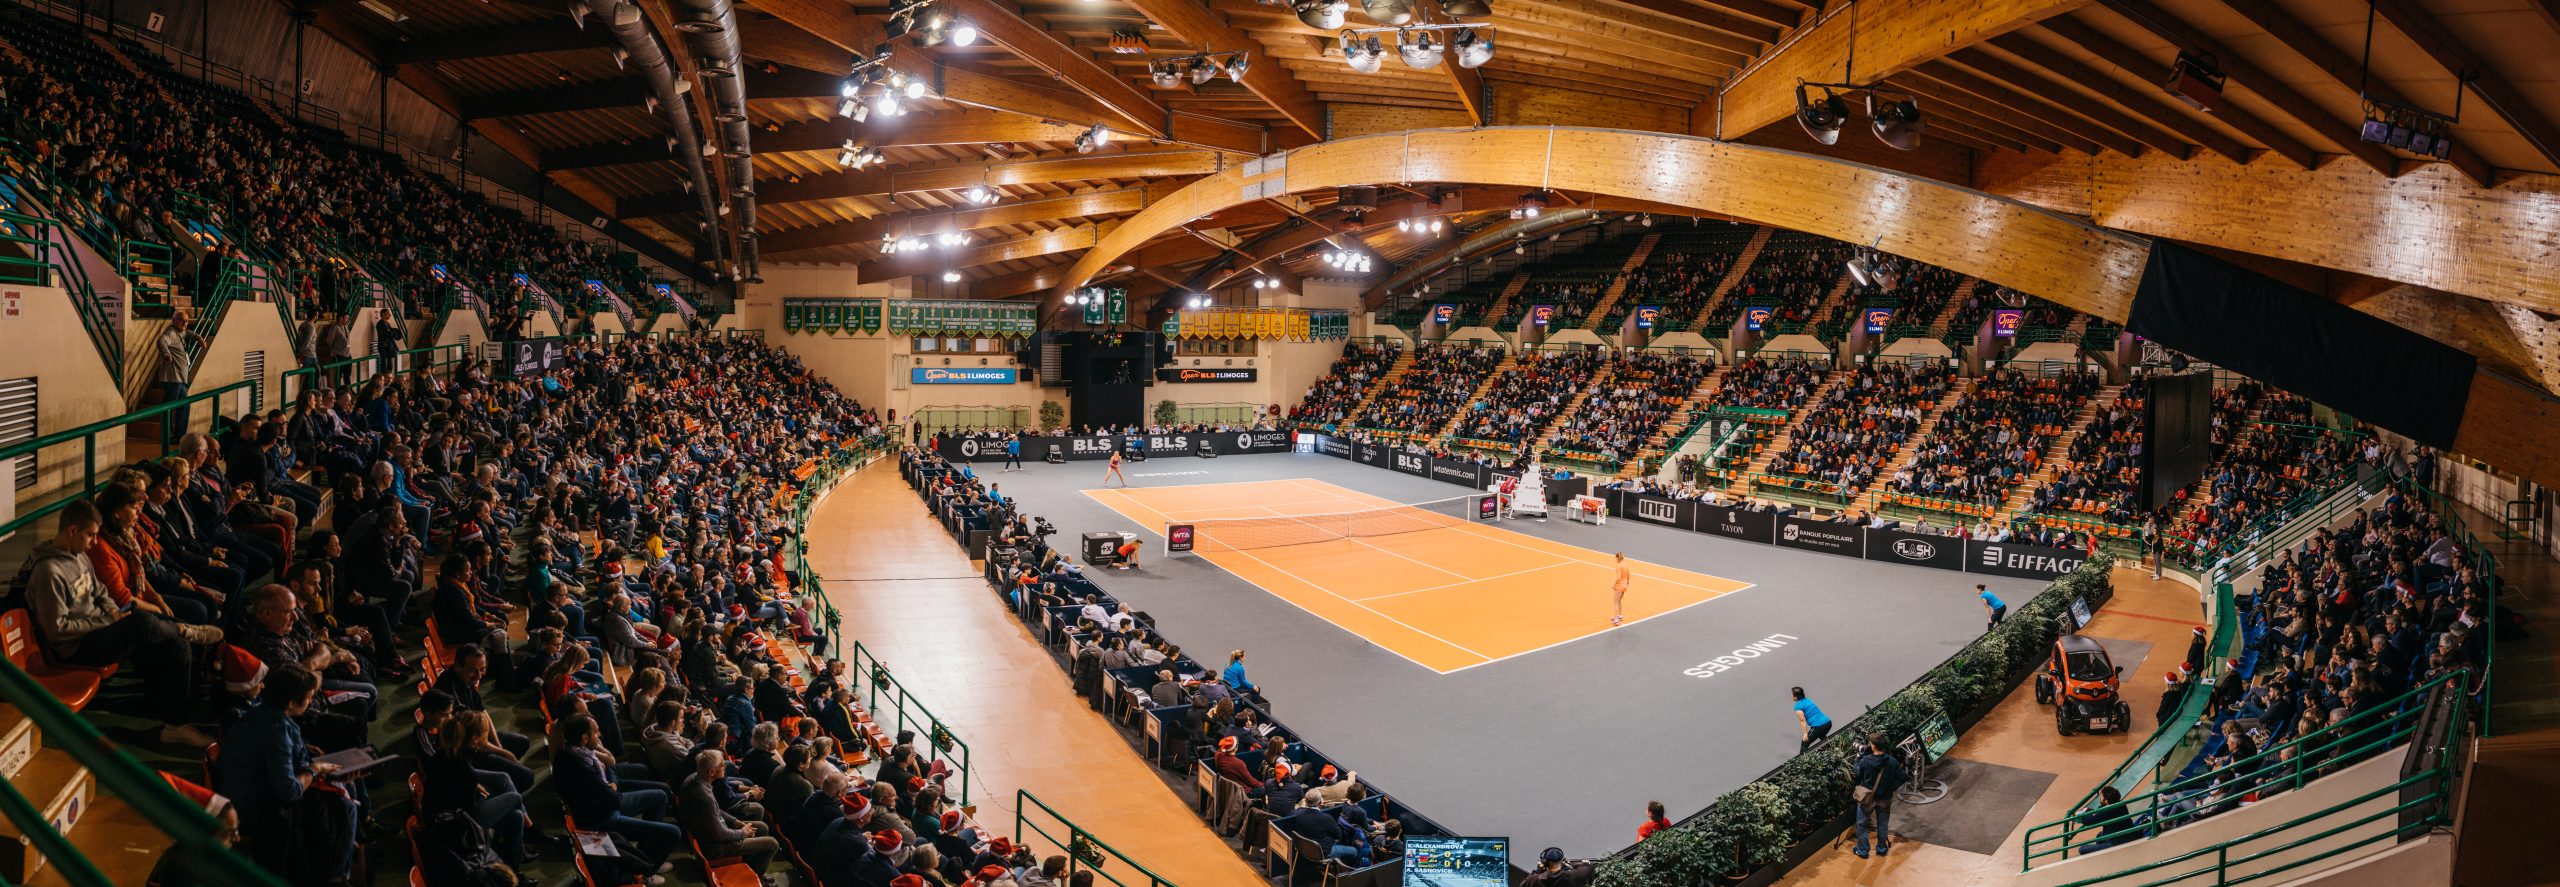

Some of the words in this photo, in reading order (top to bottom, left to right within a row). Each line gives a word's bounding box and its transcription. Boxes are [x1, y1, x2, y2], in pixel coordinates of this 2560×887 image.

[152, 16, 159, 28] 7
[303, 80, 311, 92] 5
[1114, 300, 1121, 312] 7
[925, 369, 948, 383] Open
[1180, 369, 1200, 382] Open
[1073, 438, 1112, 450] BLS
[1151, 436, 1187, 448] BLS
[1398, 454, 1422, 469] BLS
[1434, 465, 1474, 479] wtatennis.com
[1721, 524, 1744, 534] TAYON
[1823, 534, 1853, 542] POPULAIRE
[1683, 633, 1799, 678] LIMOGES
